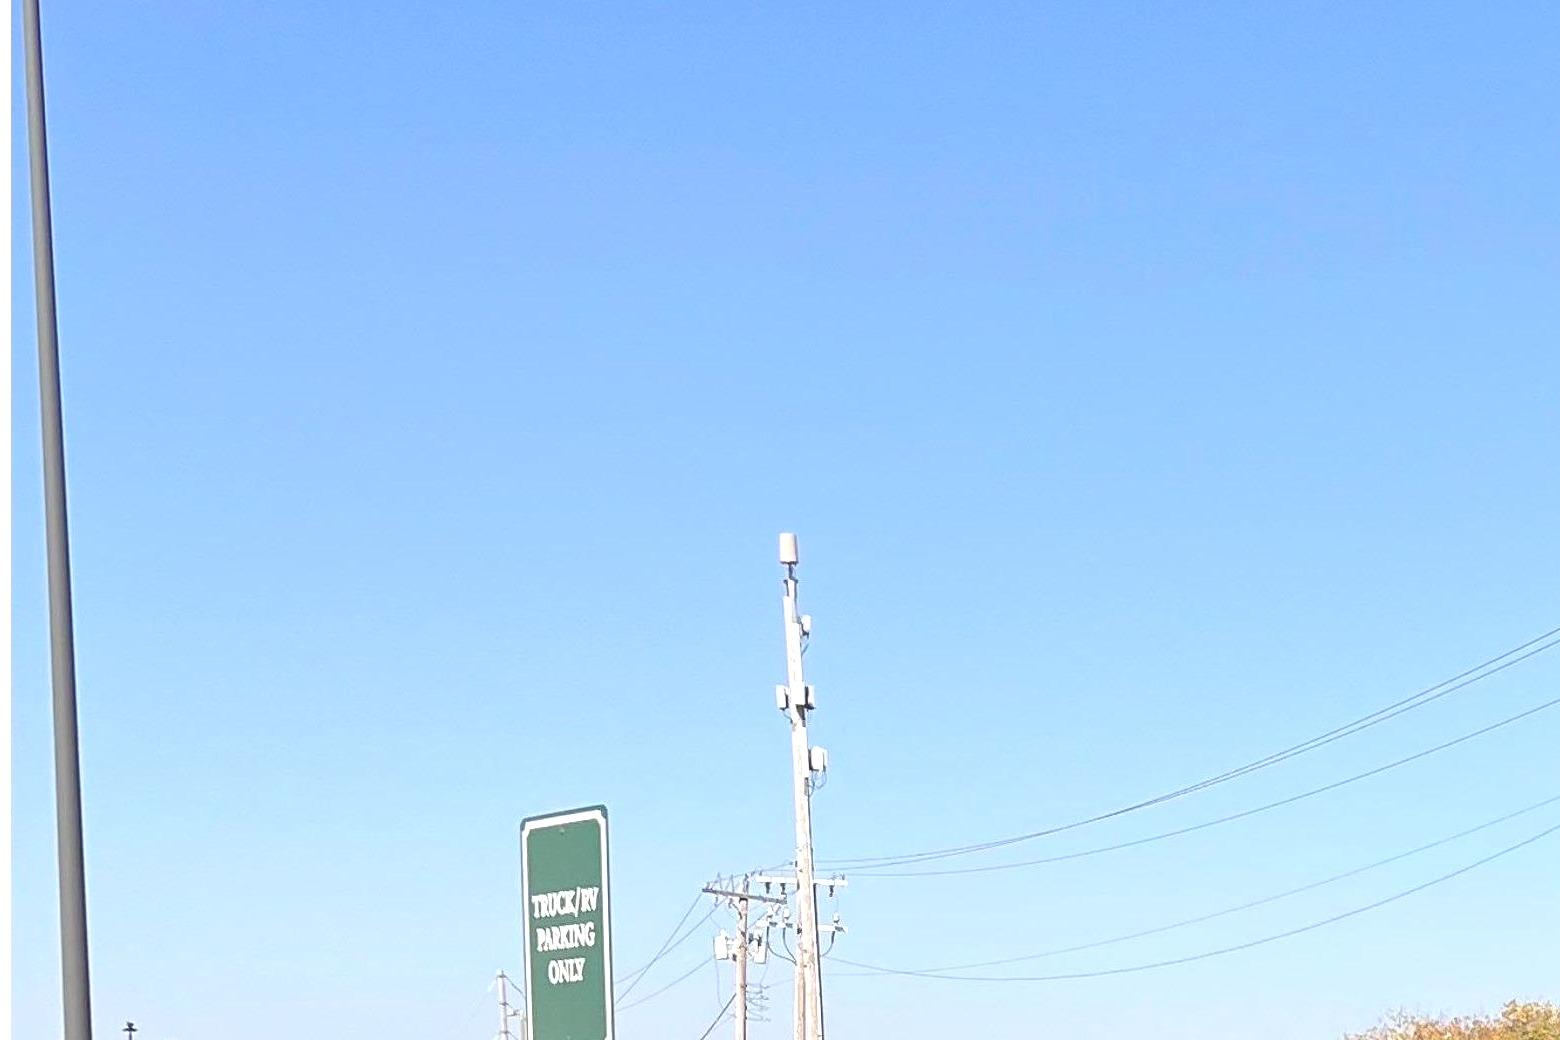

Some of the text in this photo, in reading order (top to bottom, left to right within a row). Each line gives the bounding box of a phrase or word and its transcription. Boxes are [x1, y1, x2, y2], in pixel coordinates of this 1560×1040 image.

[531, 886, 599, 918] TRUCK/RV
[536, 921, 596, 952] PARKING
[547, 957, 586, 985] ONLY
